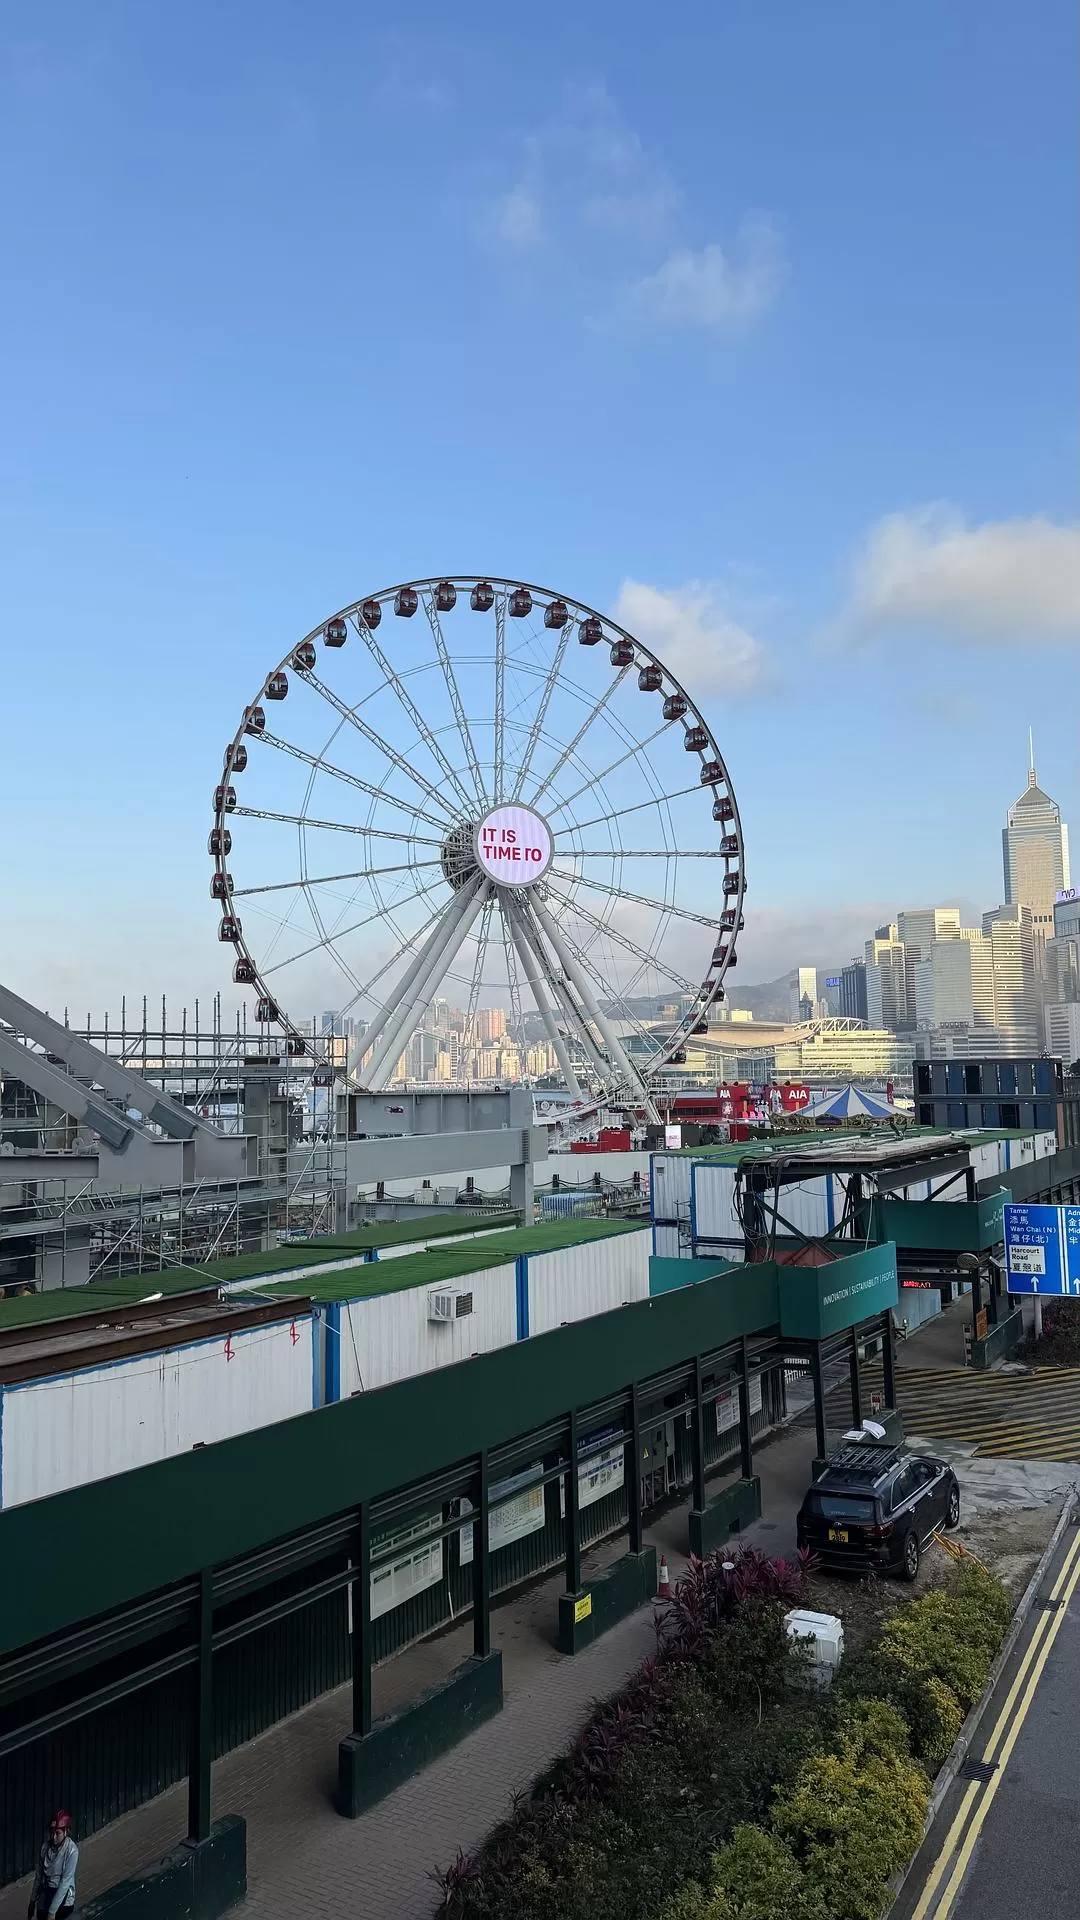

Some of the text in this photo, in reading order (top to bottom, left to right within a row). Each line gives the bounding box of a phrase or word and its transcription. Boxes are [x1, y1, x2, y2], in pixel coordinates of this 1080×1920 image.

[482, 828, 516, 843] IT IS
[483, 846, 521, 860] TIME
[789, 1090, 807, 1099] AIA
[823, 1270, 895, 1306] INNOVATION SUSTAINABILITY PEOPLE
